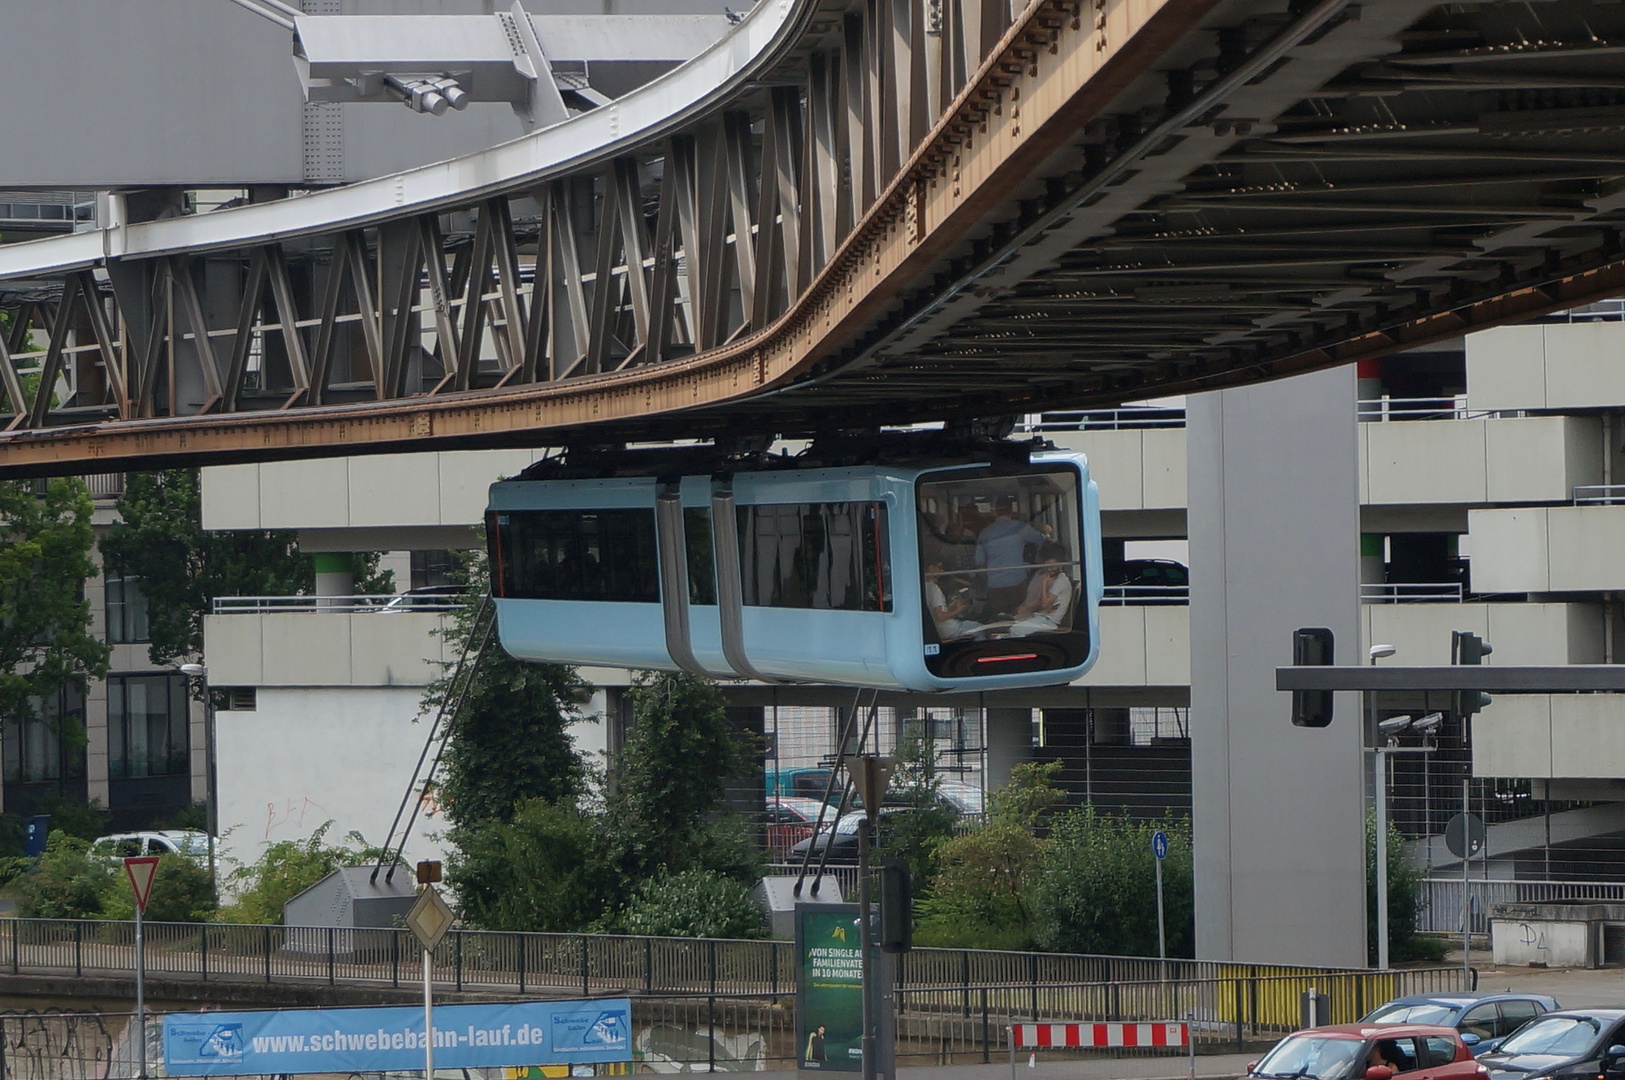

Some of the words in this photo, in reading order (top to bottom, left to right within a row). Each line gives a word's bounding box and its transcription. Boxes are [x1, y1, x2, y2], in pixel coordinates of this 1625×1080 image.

[811, 948, 828, 957] VON
[828, 948, 853, 957] SINGLE
[812, 958, 863, 968] FAMILIENVATE
[812, 969, 821, 977] IN
[822, 969, 831, 977] 10
[832, 969, 864, 979] MONATE
[253, 1024, 543, 1053] www.schwebebahn-lauf.de
